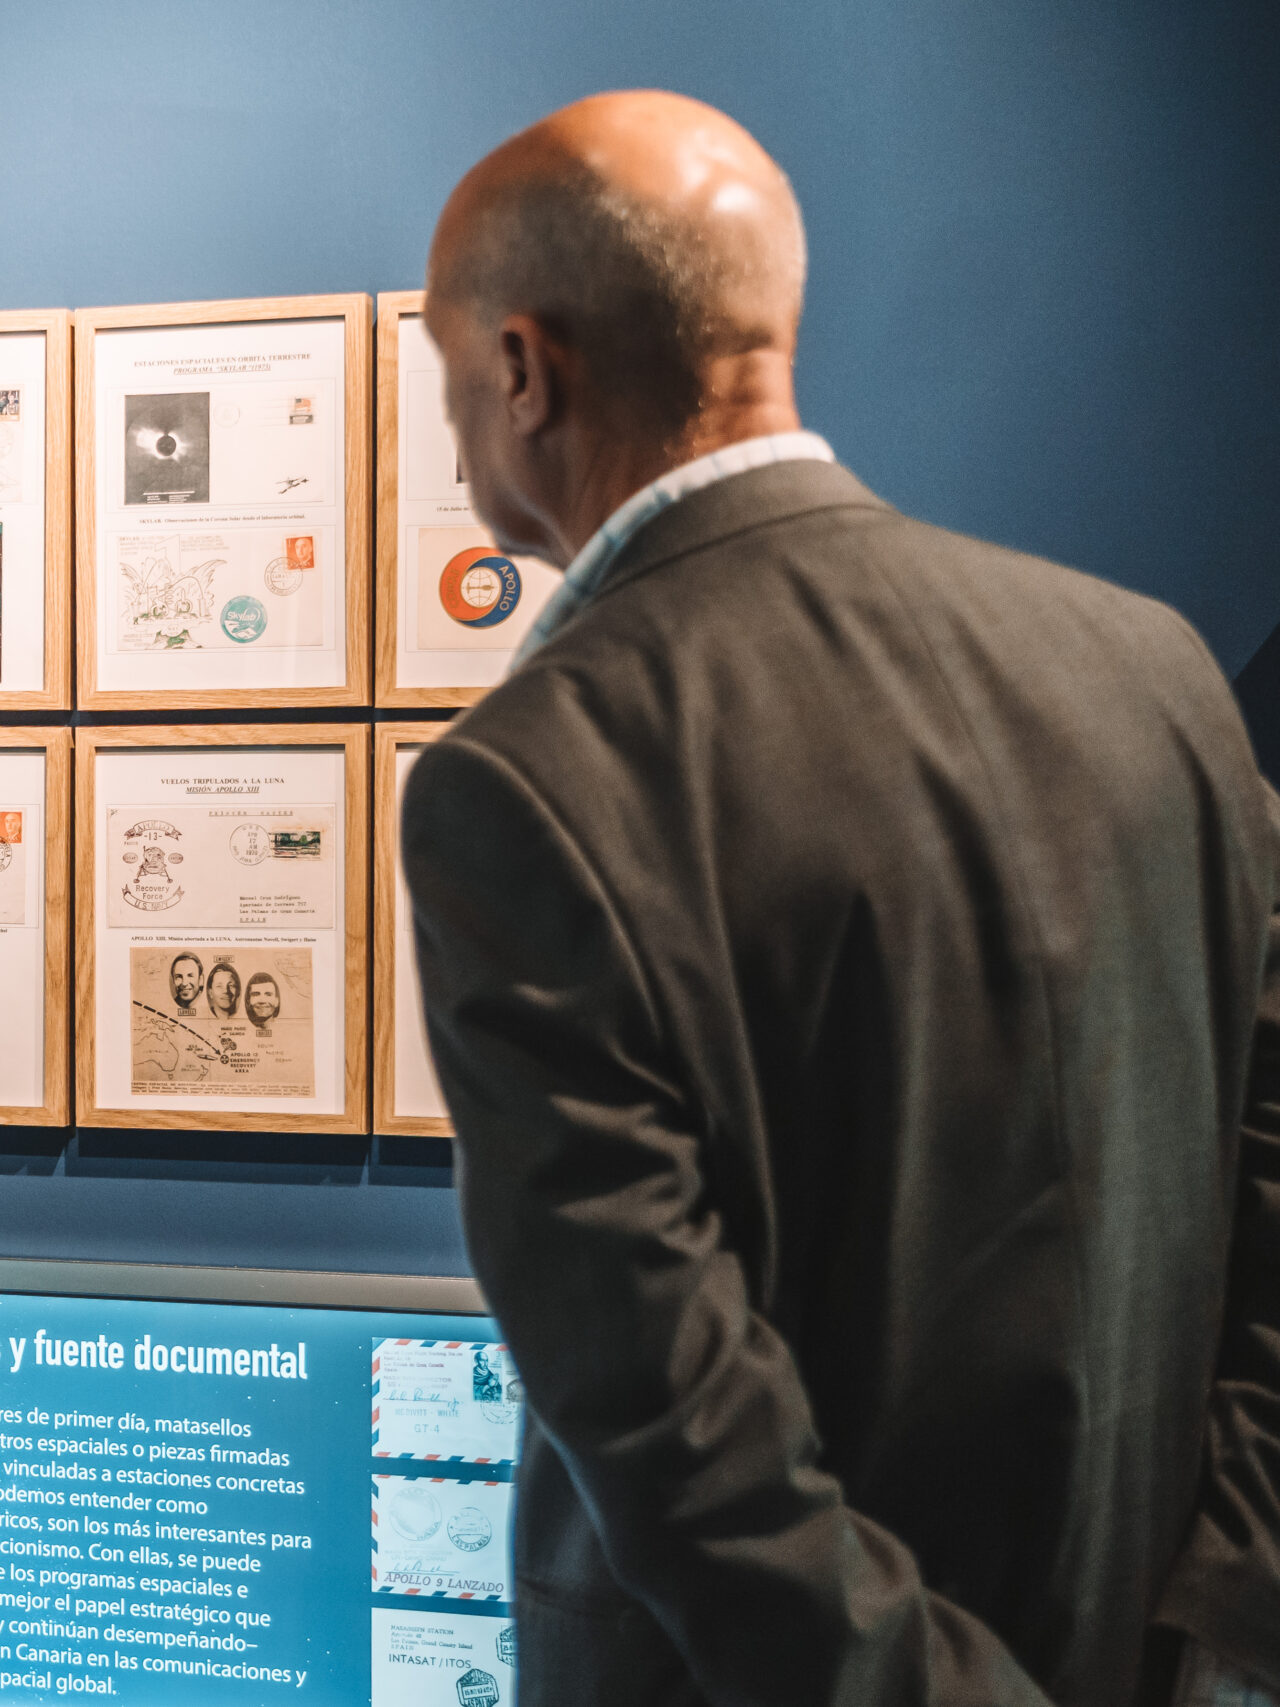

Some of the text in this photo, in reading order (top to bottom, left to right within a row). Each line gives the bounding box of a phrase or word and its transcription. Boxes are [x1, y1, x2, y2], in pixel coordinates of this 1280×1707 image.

[498, 565, 516, 611] APOLLO
[136, 885, 169, 893] Recovery
[8, 1336, 27, 1373] y
[33, 1331, 124, 1369] fuente
[133, 1336, 307, 1379] documental
[26, 1406, 49, 1425] de
[53, 1409, 114, 1429] primer
[117, 1411, 150, 1433] día,
[154, 1417, 251, 1437] matasellos
[36, 1437, 128, 1456] espaciales
[131, 1443, 145, 1457] o
[149, 1441, 205, 1462] piezas
[209, 1443, 290, 1466] firmadas
[2, 1458, 97, 1480] vinculadas
[100, 1468, 111, 1482] a
[115, 1467, 211, 1488] estaciones
[215, 1475, 305, 1494] concretas
[69, 1491, 152, 1510] entender
[155, 1498, 208, 1515] como
[47, 1517, 79, 1532] son
[83, 1515, 109, 1535] los
[113, 1519, 151, 1537] más
[155, 1520, 266, 1546] interesantes
[271, 1533, 311, 1550] para
[87, 1542, 124, 1562] Con
[128, 1545, 173, 1568] ellas,
[177, 1553, 197, 1568] se
[201, 1553, 261, 1572] puede
[9, 1562, 35, 1582] los
[39, 1569, 135, 1590] programas
[139, 1576, 233, 1597] espaciales
[236, 1584, 249, 1598] e
[384, 1573, 504, 1592] APOLLO 9 LANZADO
[53, 1593, 70, 1611] el
[75, 1597, 125, 1618] papel
[129, 1601, 231, 1626] estratégico
[234, 1611, 271, 1629] que
[8, 1618, 99, 1640] continúan
[15, 1642, 82, 1665] Canaria
[86, 1652, 109, 1667] en
[114, 1649, 138, 1670] las
[142, 1657, 291, 1682] comunicaciones
[295, 1669, 307, 1688] y
[389, 1654, 436, 1665] INTASAT
[445, 1659, 471, 1668] ITOS
[55, 1672, 117, 1695] global.
